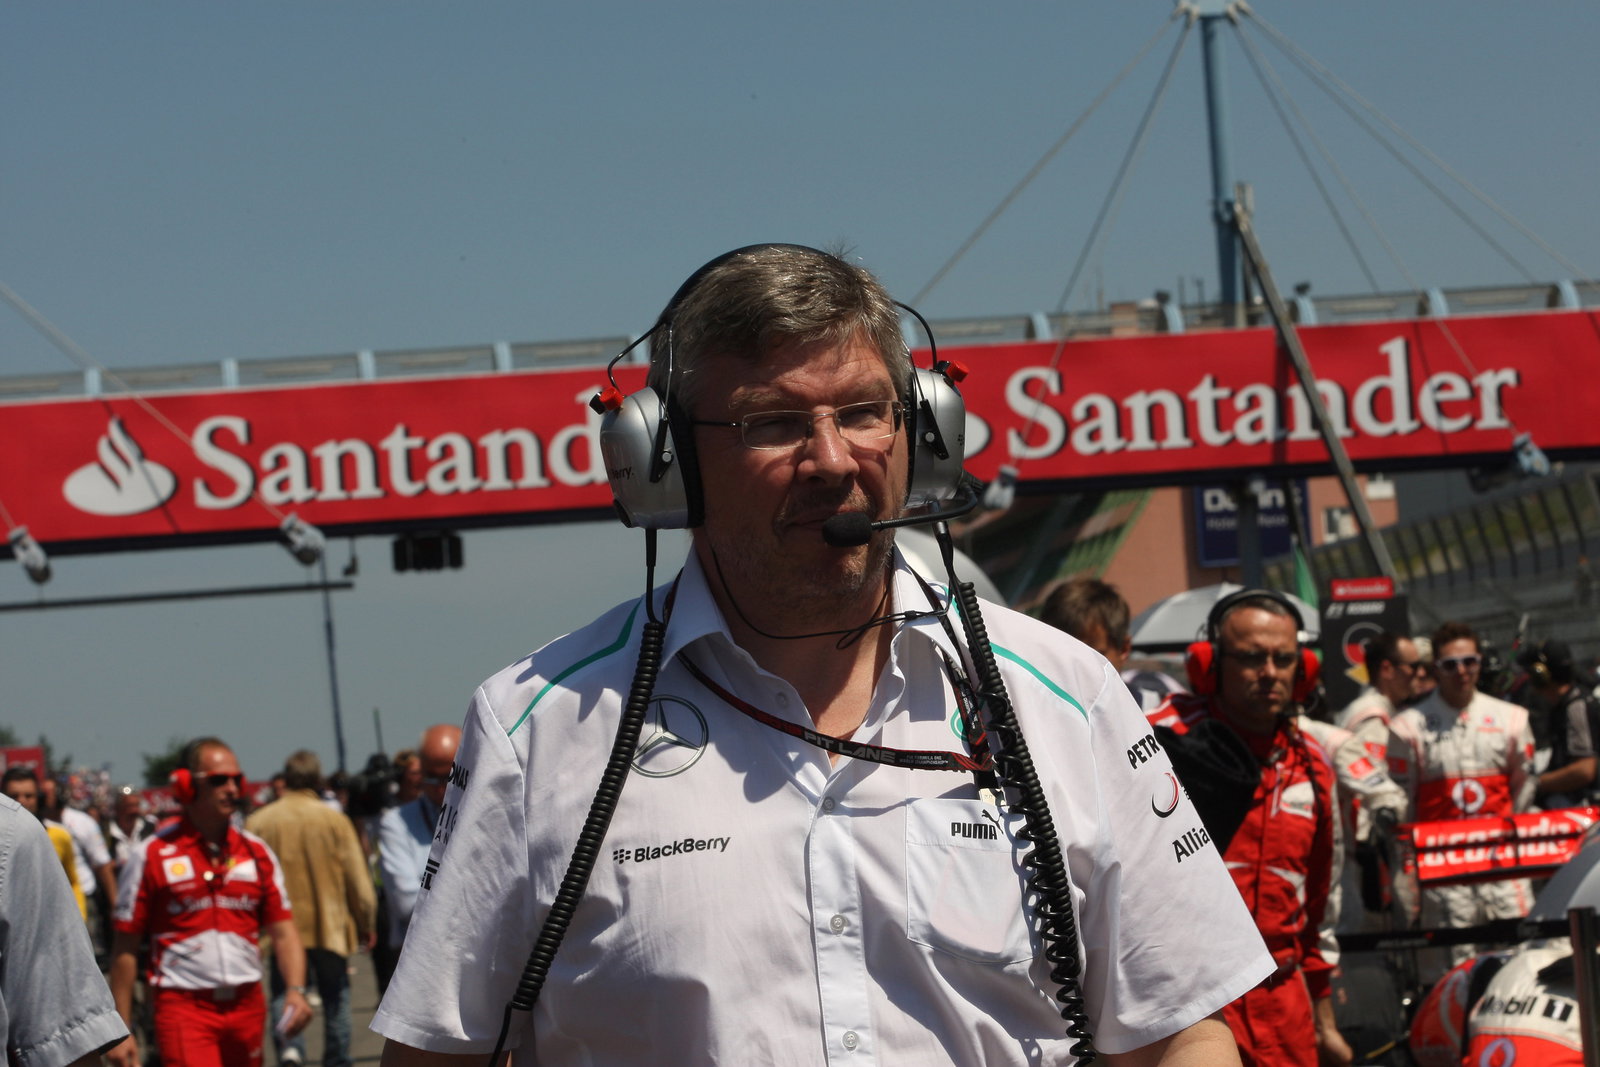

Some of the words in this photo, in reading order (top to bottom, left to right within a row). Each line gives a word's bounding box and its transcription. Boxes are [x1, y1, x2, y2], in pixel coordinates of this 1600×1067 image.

[1005, 336, 1521, 460] Santander
[804, 731, 835, 749] PIT
[838, 742, 896, 764] LANE
[1127, 734, 1161, 769] PETR
[951, 822, 998, 840] PUMA
[1172, 827, 1211, 863] Allia
[634, 837, 731, 863] BlackBerry
